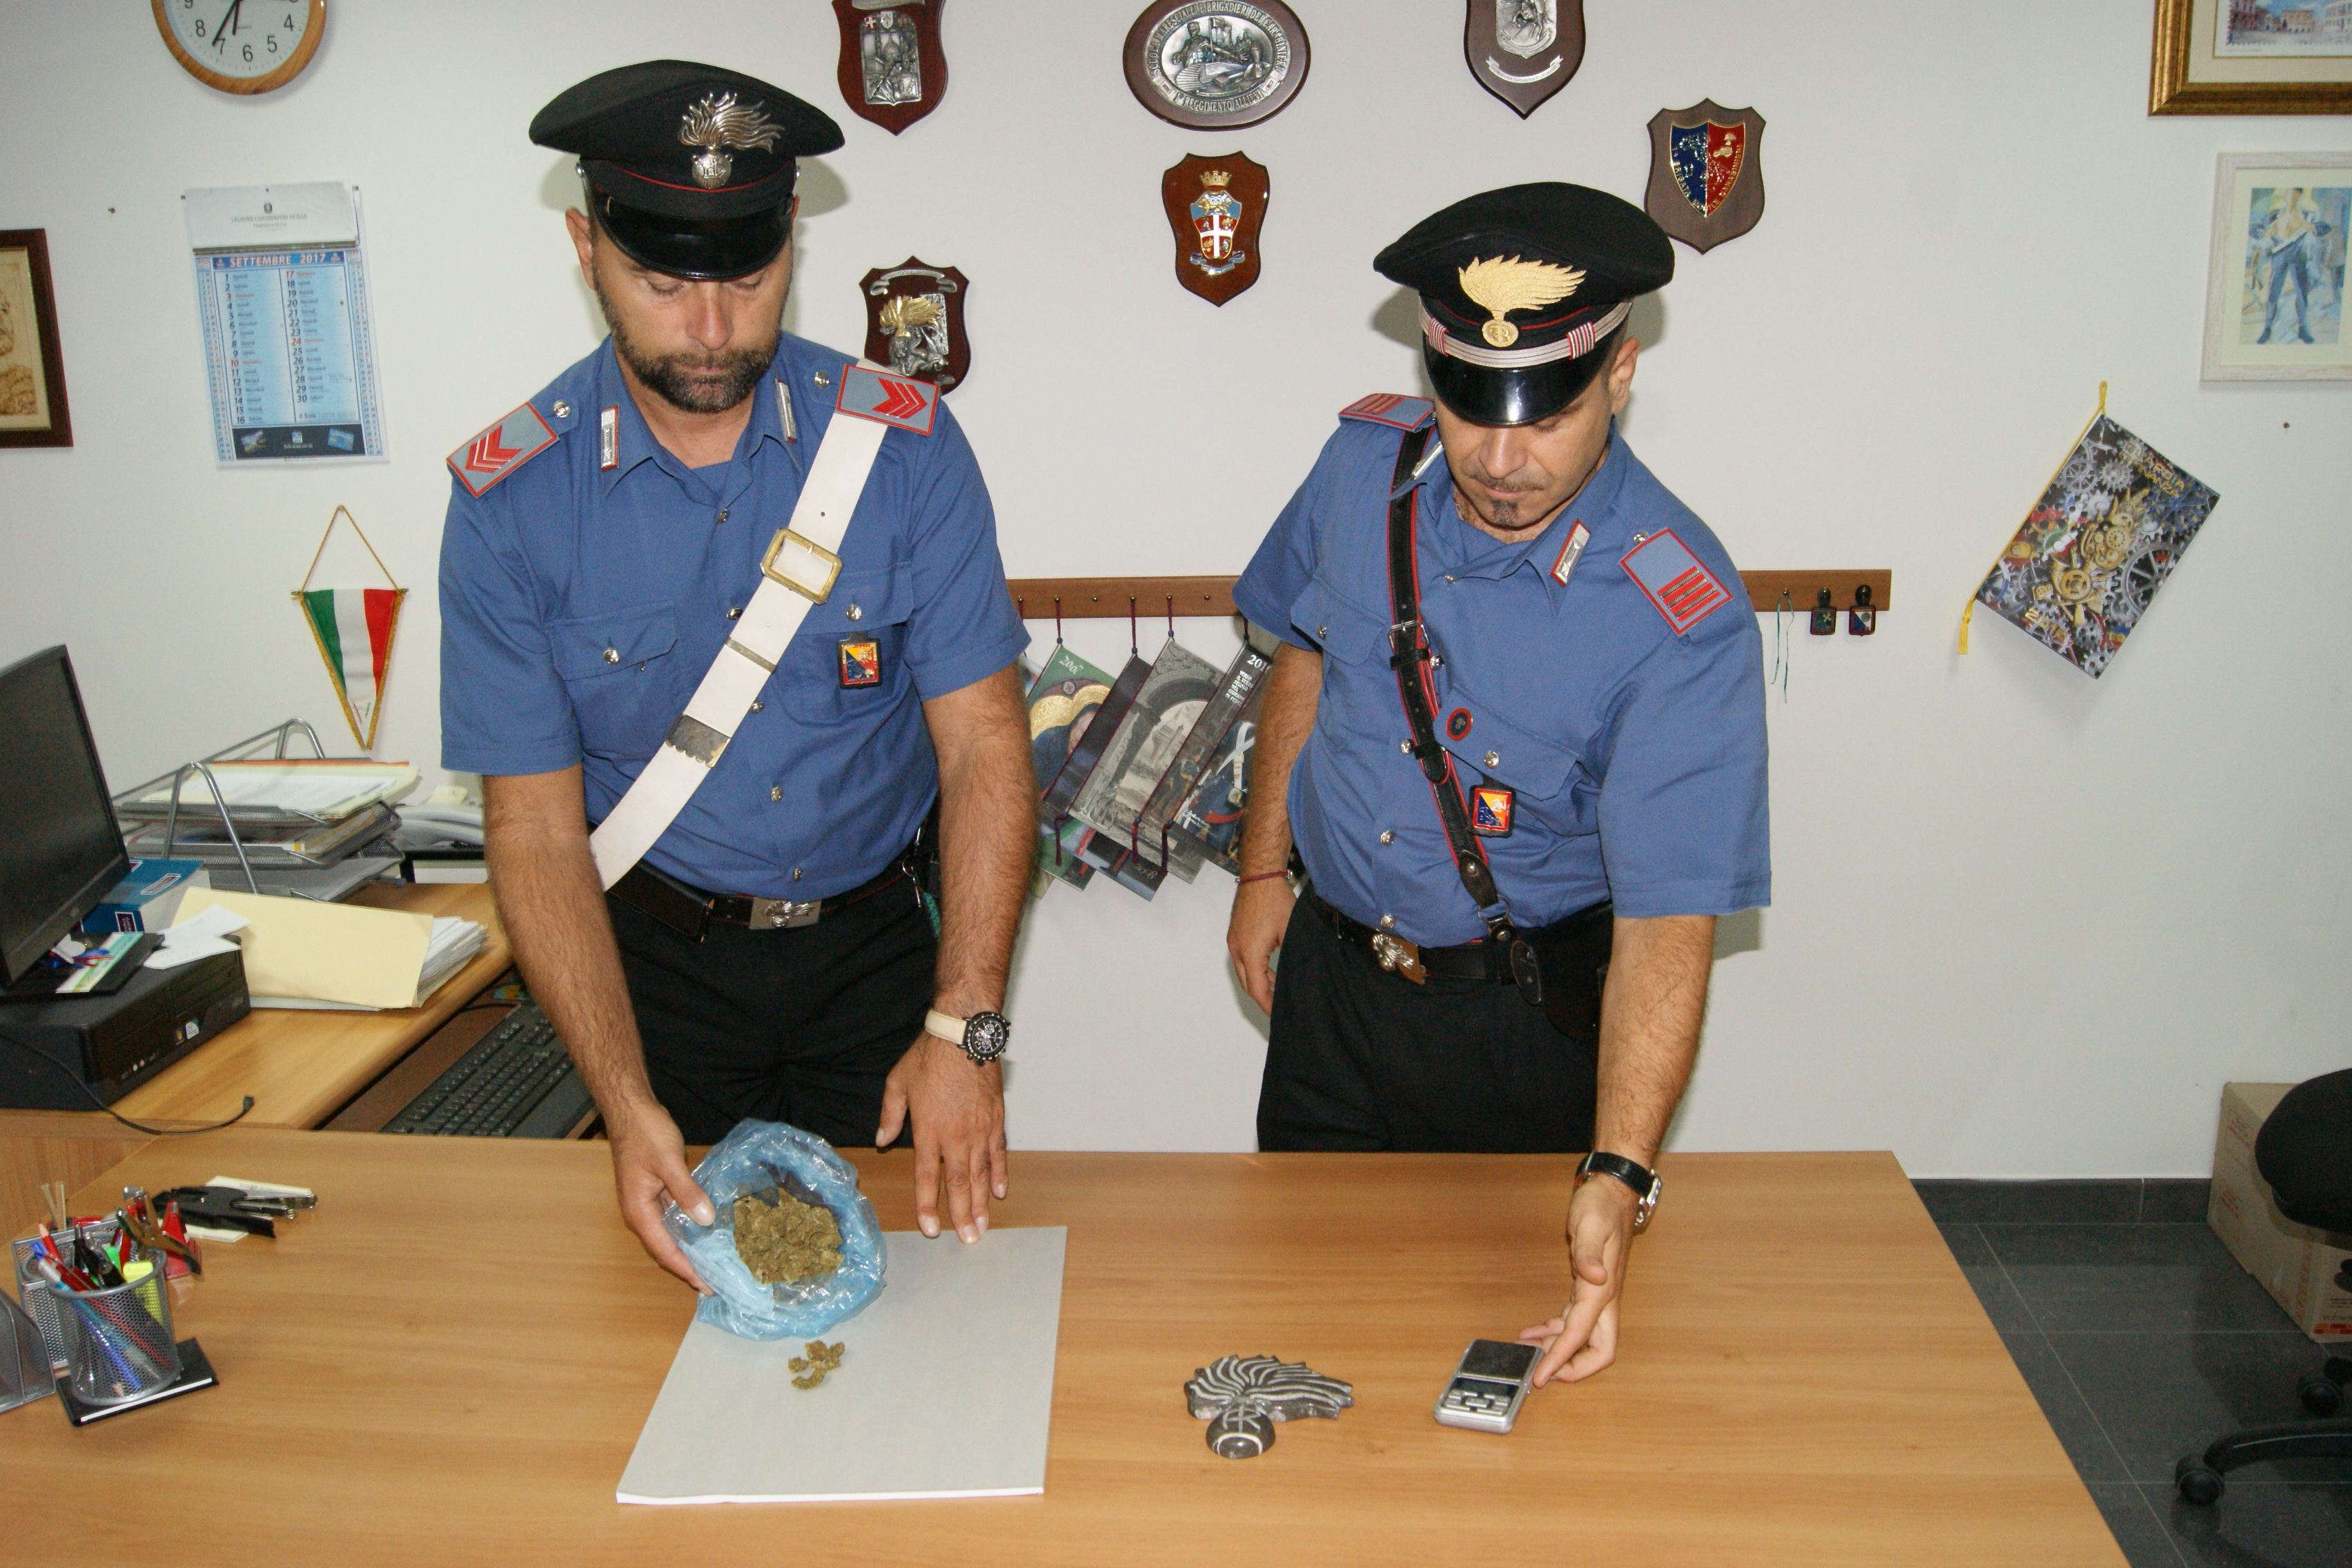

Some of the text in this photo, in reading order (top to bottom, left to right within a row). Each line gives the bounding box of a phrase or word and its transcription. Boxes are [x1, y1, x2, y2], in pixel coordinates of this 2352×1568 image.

[195, 19, 206, 37] 8
[284, 14, 294, 32] 4
[216, 37, 226, 55] 7
[267, 35, 277, 53] 5
[1148, 2, 1288, 75] SCUOLA MARESCIALLI E BRIGADIERI DEI CARABINIERI
[242, 45, 253, 62] 6
[1184, 96, 1233, 112] REGGIMENTO
[1235, 90, 1264, 108] ALLIEVI
[1673, 161, 1692, 197] BRIGATA
[229, 253, 326, 268] SETTEMBRE 2017
[287, 280, 295, 288] 18
[288, 309, 297, 317] 21
[293, 347, 302, 355] 25
[293, 357, 304, 365] 26
[295, 375, 305, 384] 28
[297, 395, 307, 403] 30
[2126, 443, 2184, 491] GUARDIA
[1059, 655, 1084, 675] 2007
[1239, 670, 1253, 681] VERSO
[1241, 678, 1254, 688] TERZO
[1231, 684, 1239, 692] NEL
[1233, 679, 1248, 692] SECOLO
